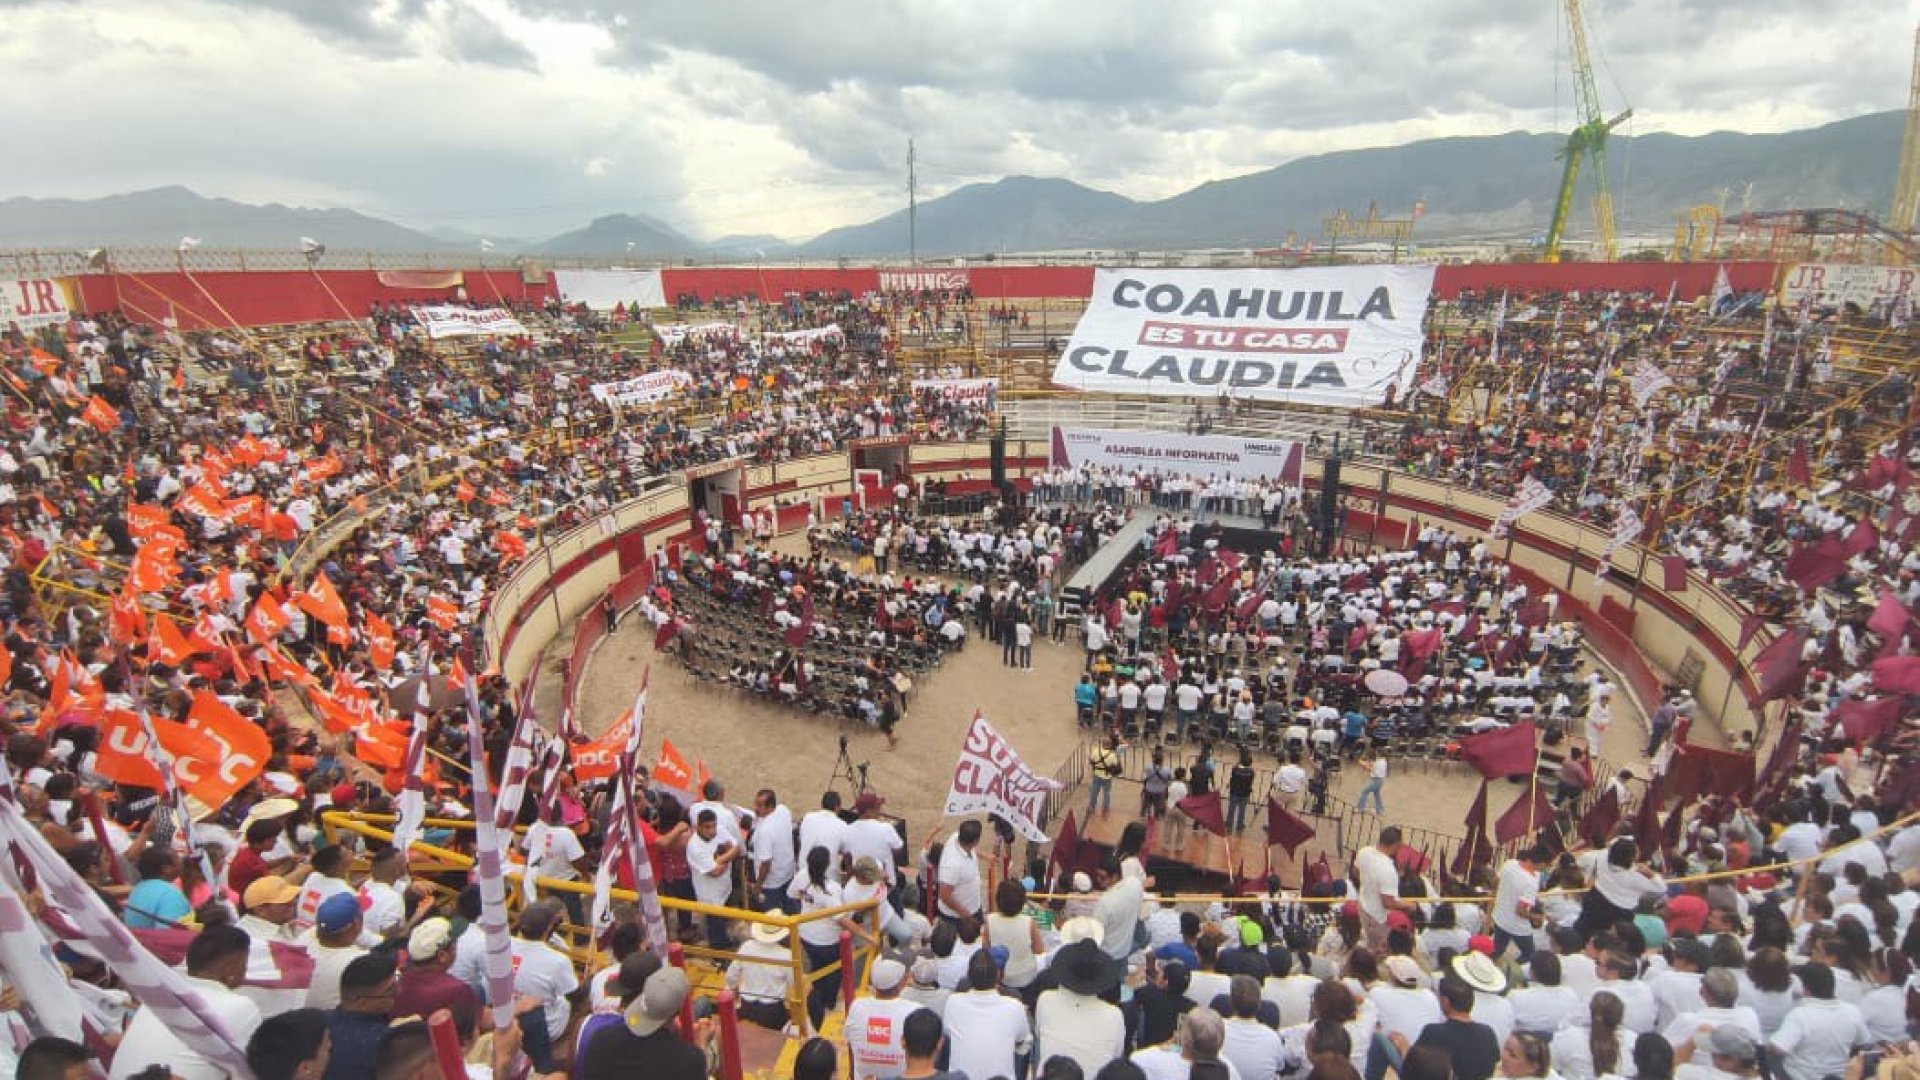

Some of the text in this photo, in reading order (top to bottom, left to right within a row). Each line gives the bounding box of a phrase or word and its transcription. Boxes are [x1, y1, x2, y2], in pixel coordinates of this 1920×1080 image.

[1112, 279, 1396, 320] COAHUILA
[1144, 326, 1338, 349] ES TU CASA
[1069, 346, 1346, 389] CLAUDIA
[1105, 444, 1162, 457] ASAMBLEA
[1165, 448, 1240, 462] INFORMATIVA
[109, 725, 202, 784] UC
[868, 1024, 891, 1036] UDC
